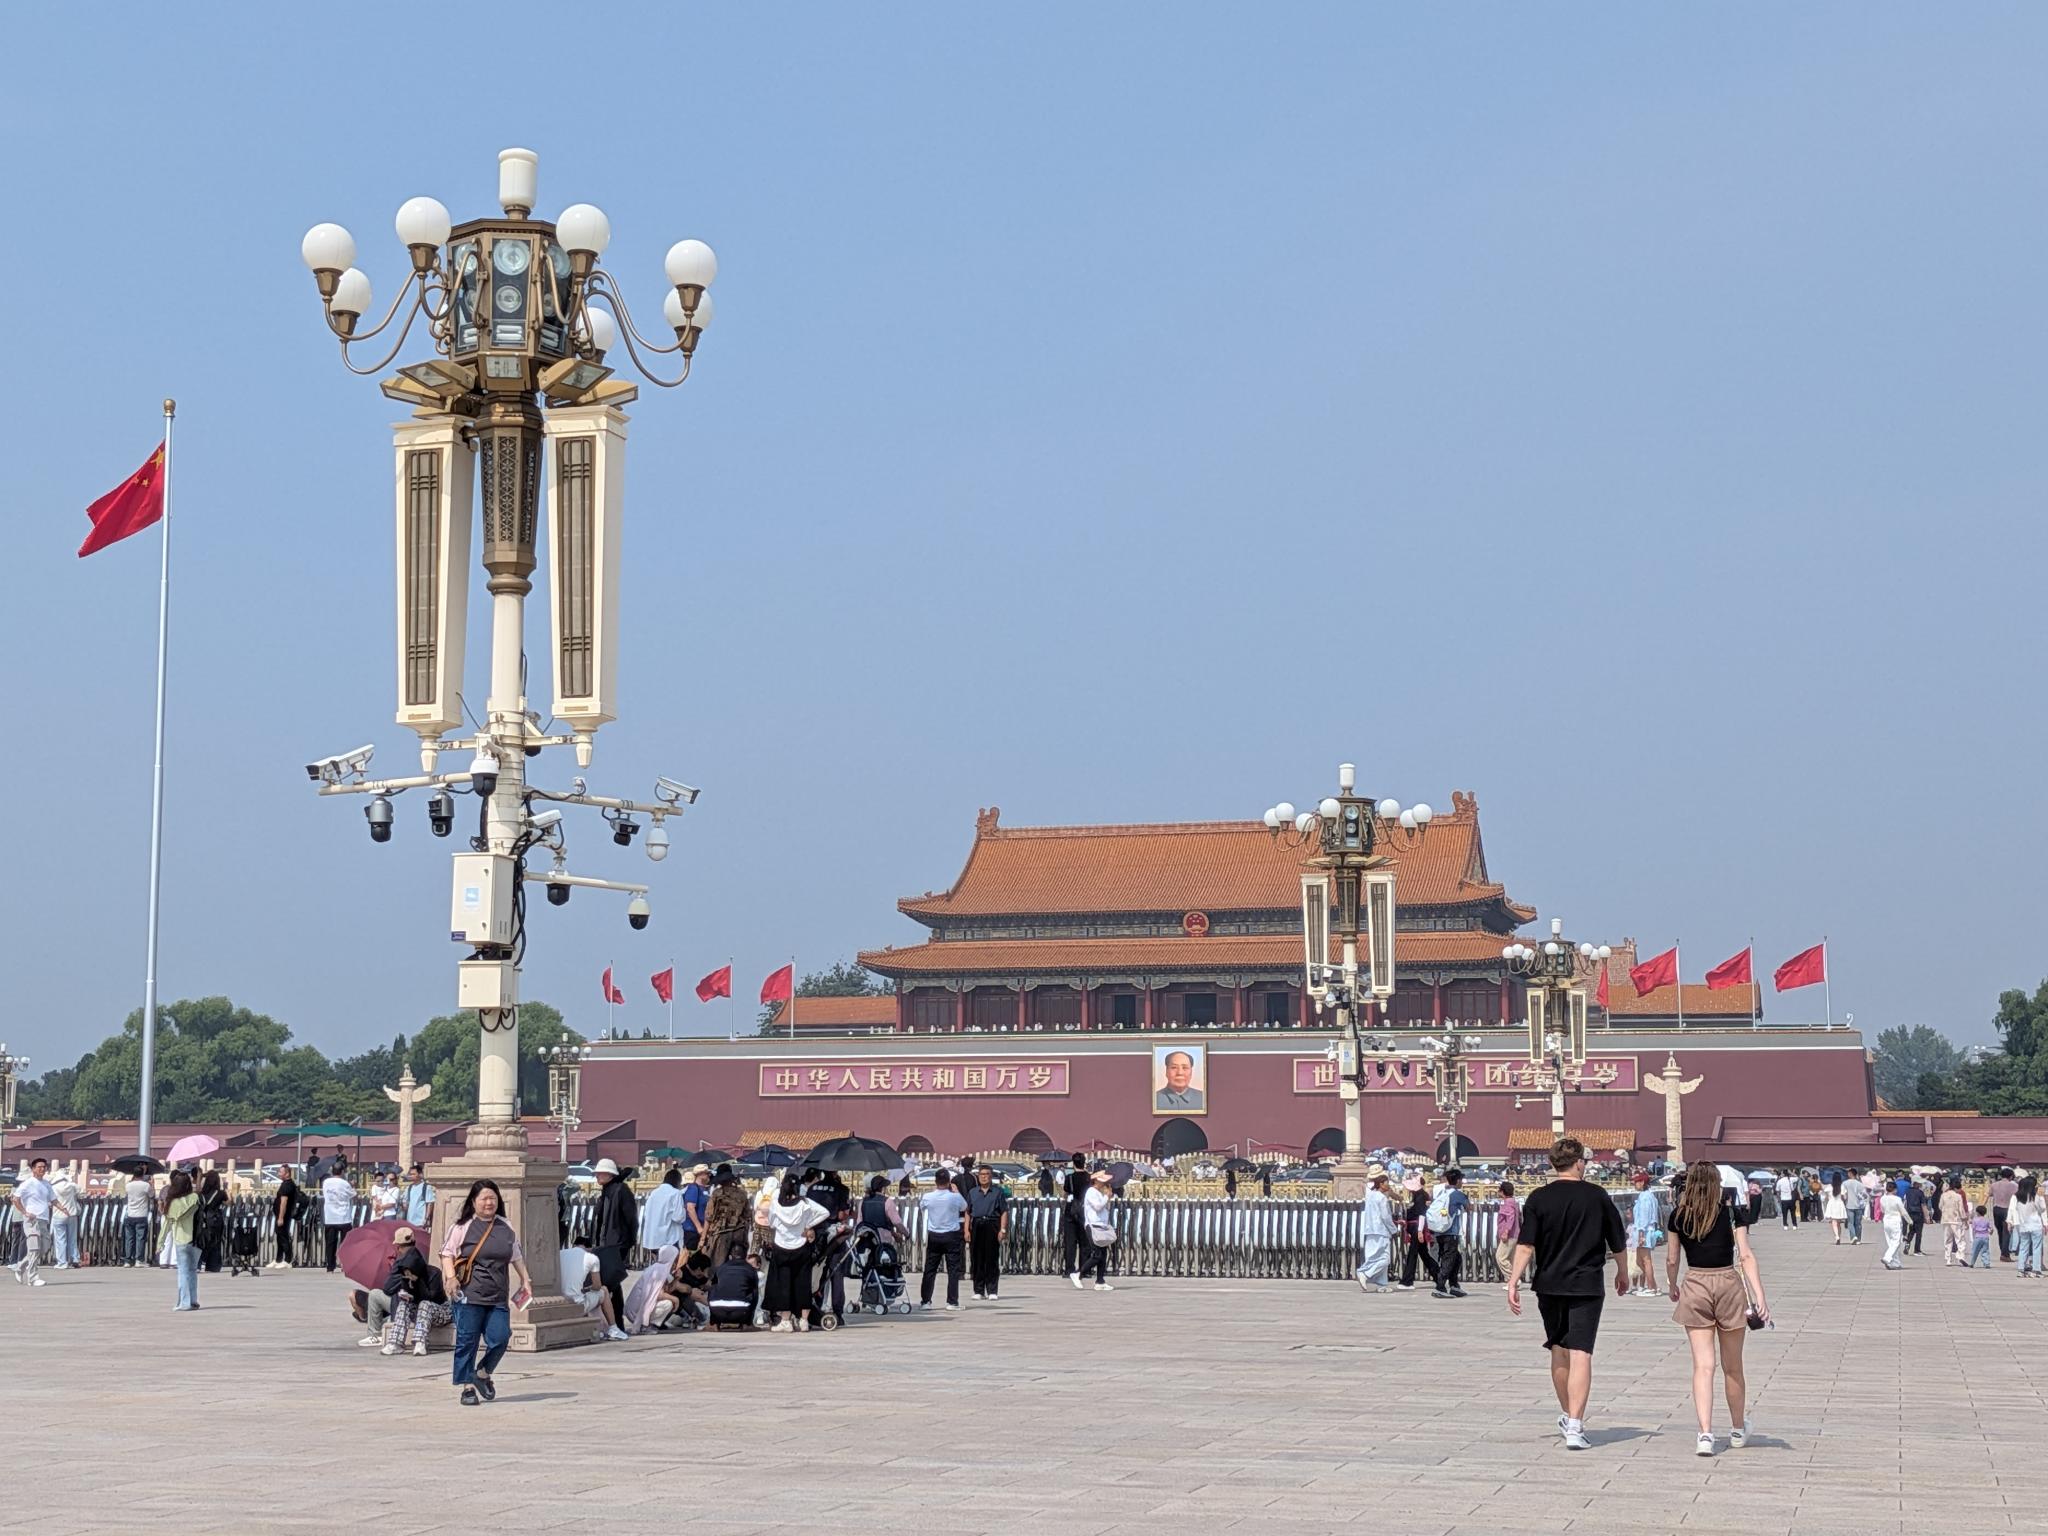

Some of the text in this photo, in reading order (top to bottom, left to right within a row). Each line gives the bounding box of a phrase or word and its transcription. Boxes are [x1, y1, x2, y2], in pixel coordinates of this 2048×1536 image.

[775, 1066, 1053, 1091] 中华人民共和国万岁
